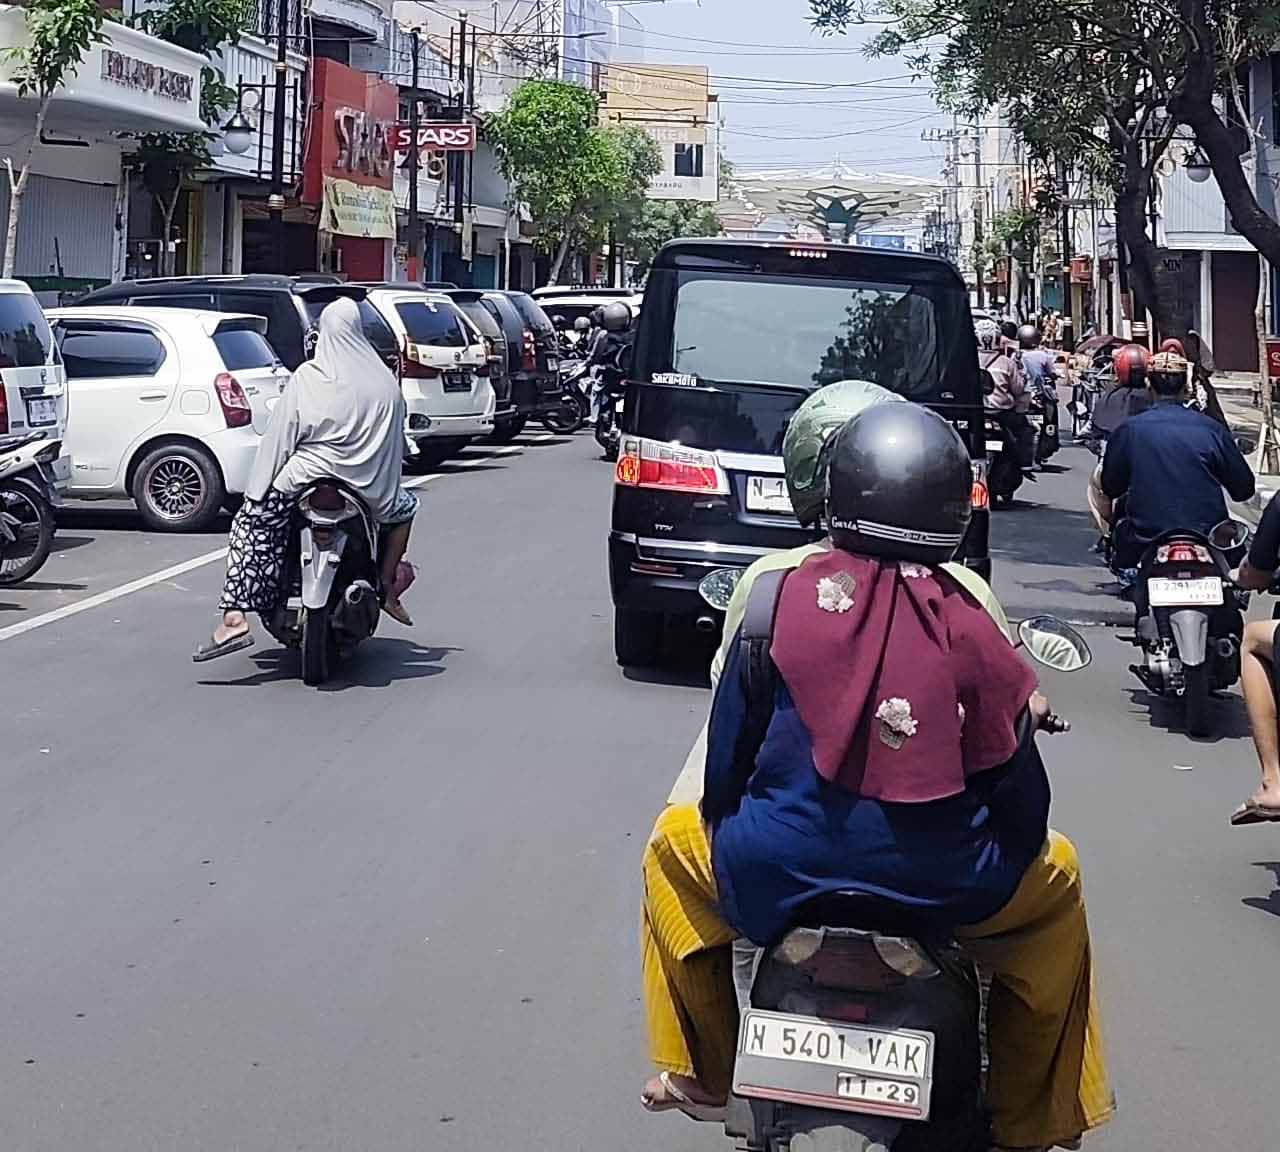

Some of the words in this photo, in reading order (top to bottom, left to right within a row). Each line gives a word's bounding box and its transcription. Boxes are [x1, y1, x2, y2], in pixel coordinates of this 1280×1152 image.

[397, 129, 471, 146] STARS
[782, 1027, 847, 1060] 5401
[868, 1037, 921, 1073] VAK
